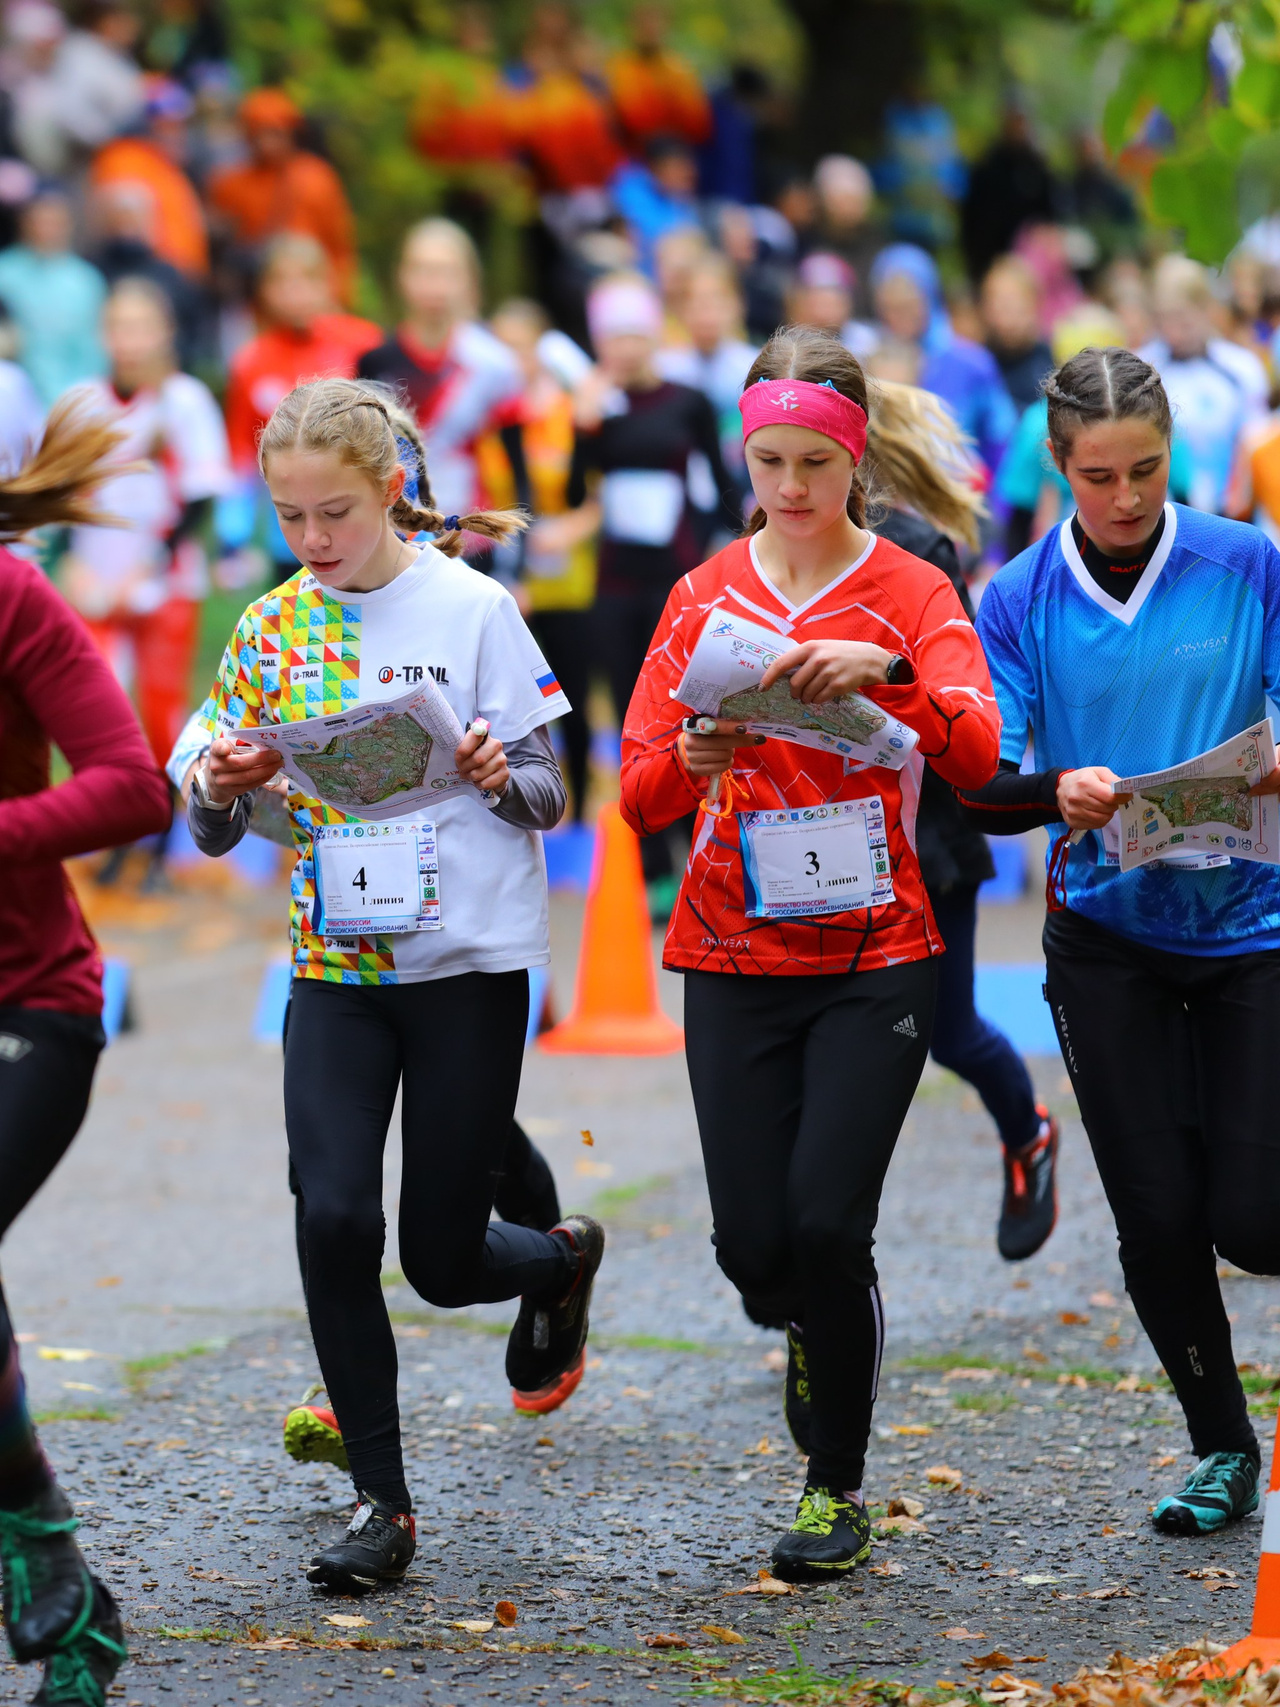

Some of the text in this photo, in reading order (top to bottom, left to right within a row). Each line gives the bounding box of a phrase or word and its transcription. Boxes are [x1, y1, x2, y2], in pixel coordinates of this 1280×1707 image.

[1109, 564, 1138, 573] CRAFT
[259, 660, 277, 668] TRAIL
[738, 658, 755, 670] Ж14
[257, 732, 278, 741] 4.2
[804, 851, 820, 876] 3
[352, 867, 367, 891] 4
[816, 876, 858, 888] 1 линия
[362, 897, 404, 905] 1 линия
[764, 899, 827, 910] ПЕРВЕНСТВО РОССИИ
[814, 901, 865, 912] СОРЕВНОВАНИЯ
[359, 924, 409, 933] СОРЕВНОВАНИЯ
[893, 1024, 918, 1038] adidas
